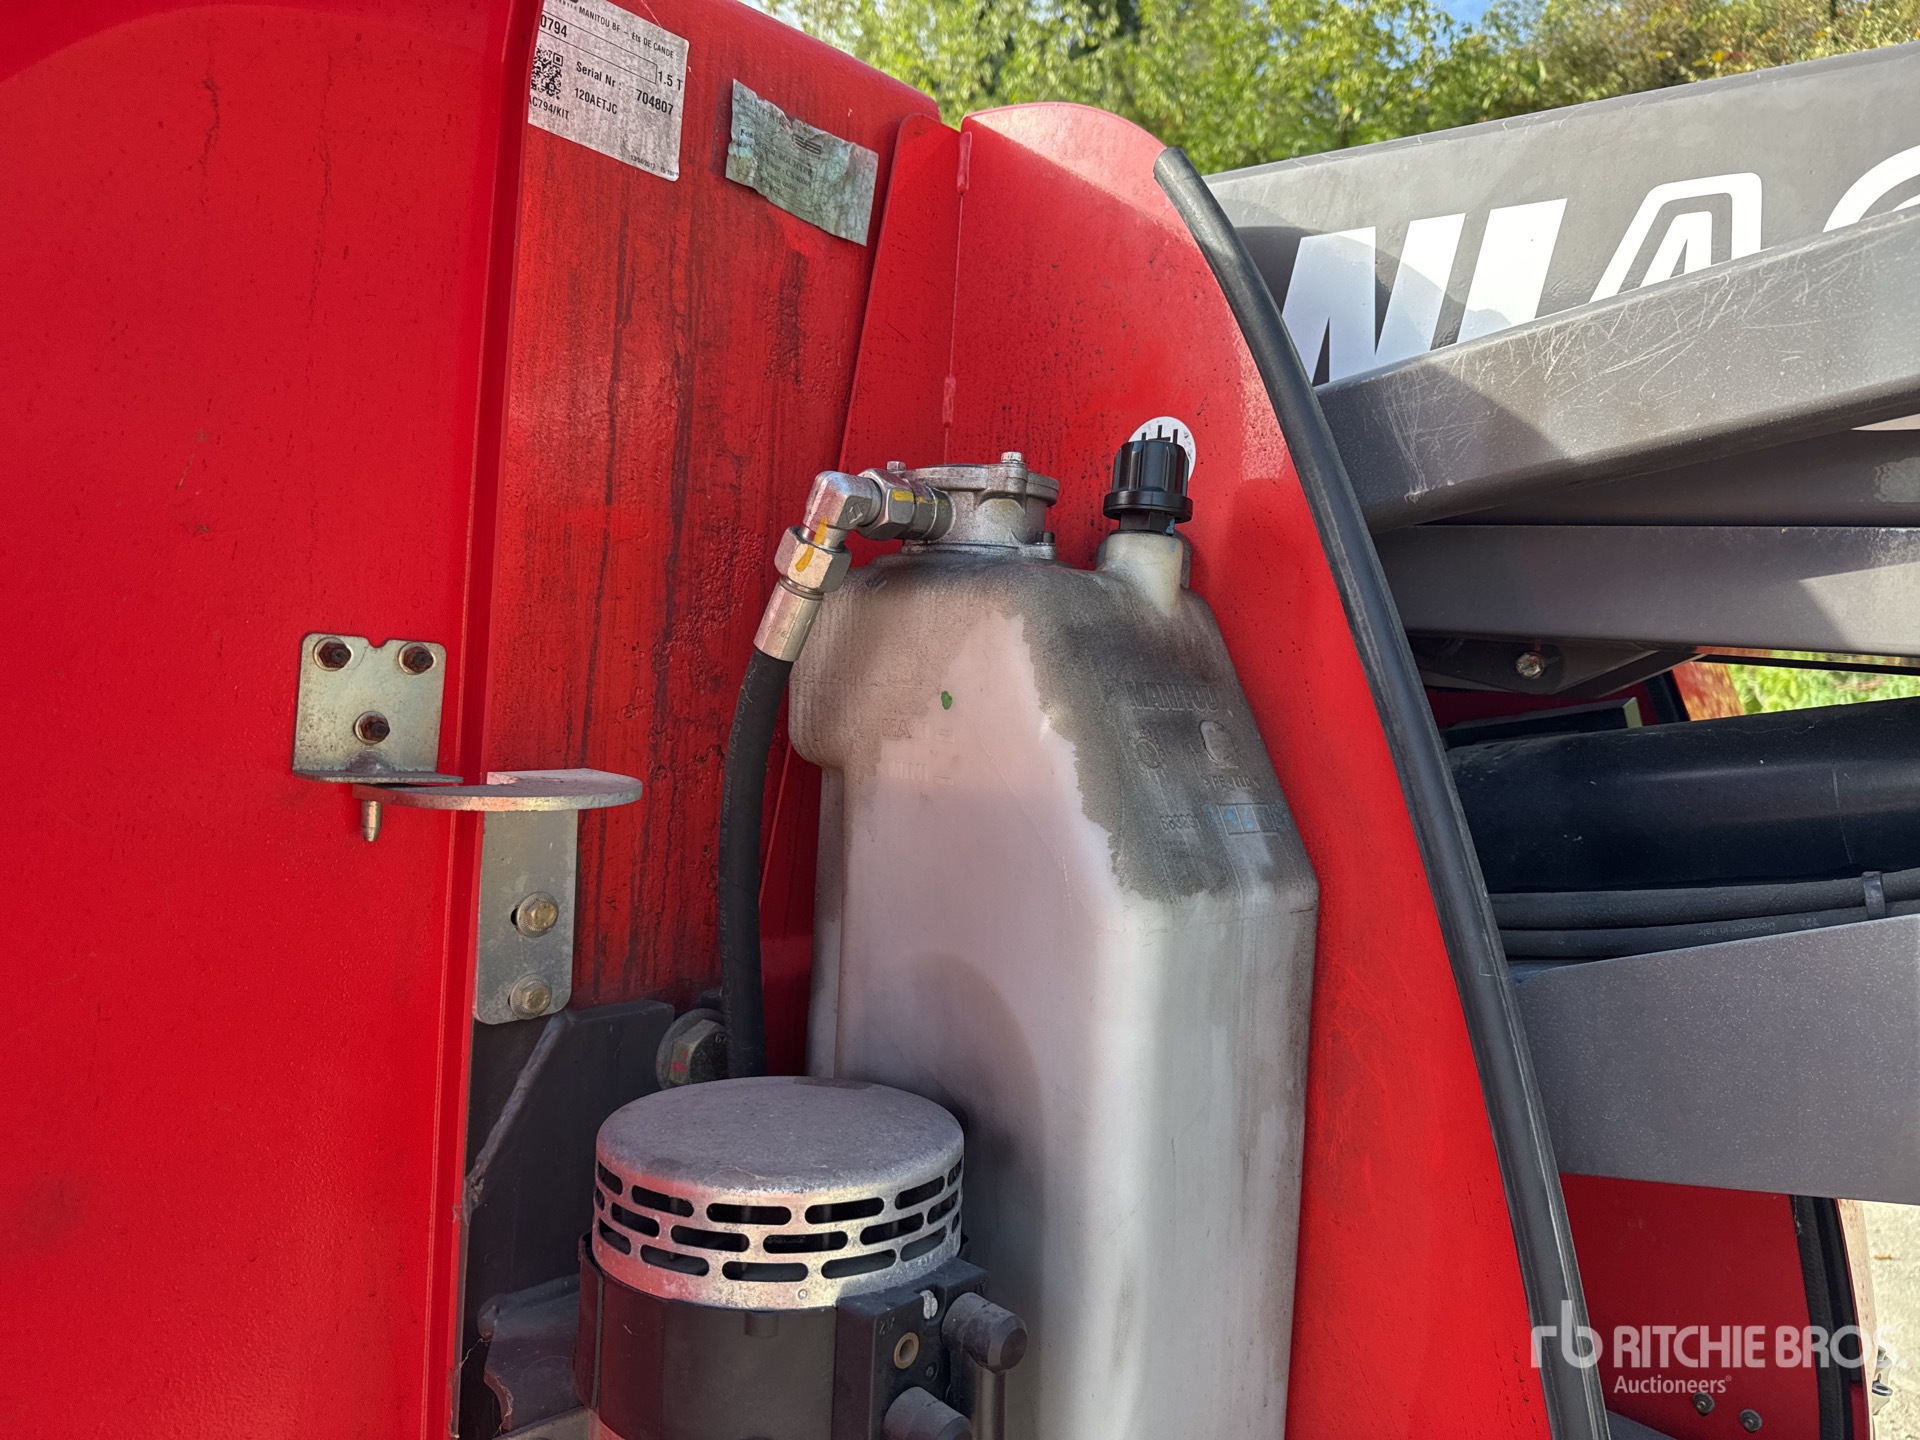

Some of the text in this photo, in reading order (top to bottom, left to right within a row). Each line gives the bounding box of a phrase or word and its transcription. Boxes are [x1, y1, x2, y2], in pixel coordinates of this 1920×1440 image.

[579, 6, 610, 27] MANITOU
[612, 22, 621, 32] BF
[643, 38, 652, 49] DE
[576, 61, 602, 81] Serial
[605, 74, 616, 88] Nr
[636, 89, 674, 116] 704807
[658, 70, 683, 91] 1.5 T
[575, 88, 618, 115] 120AETJC
